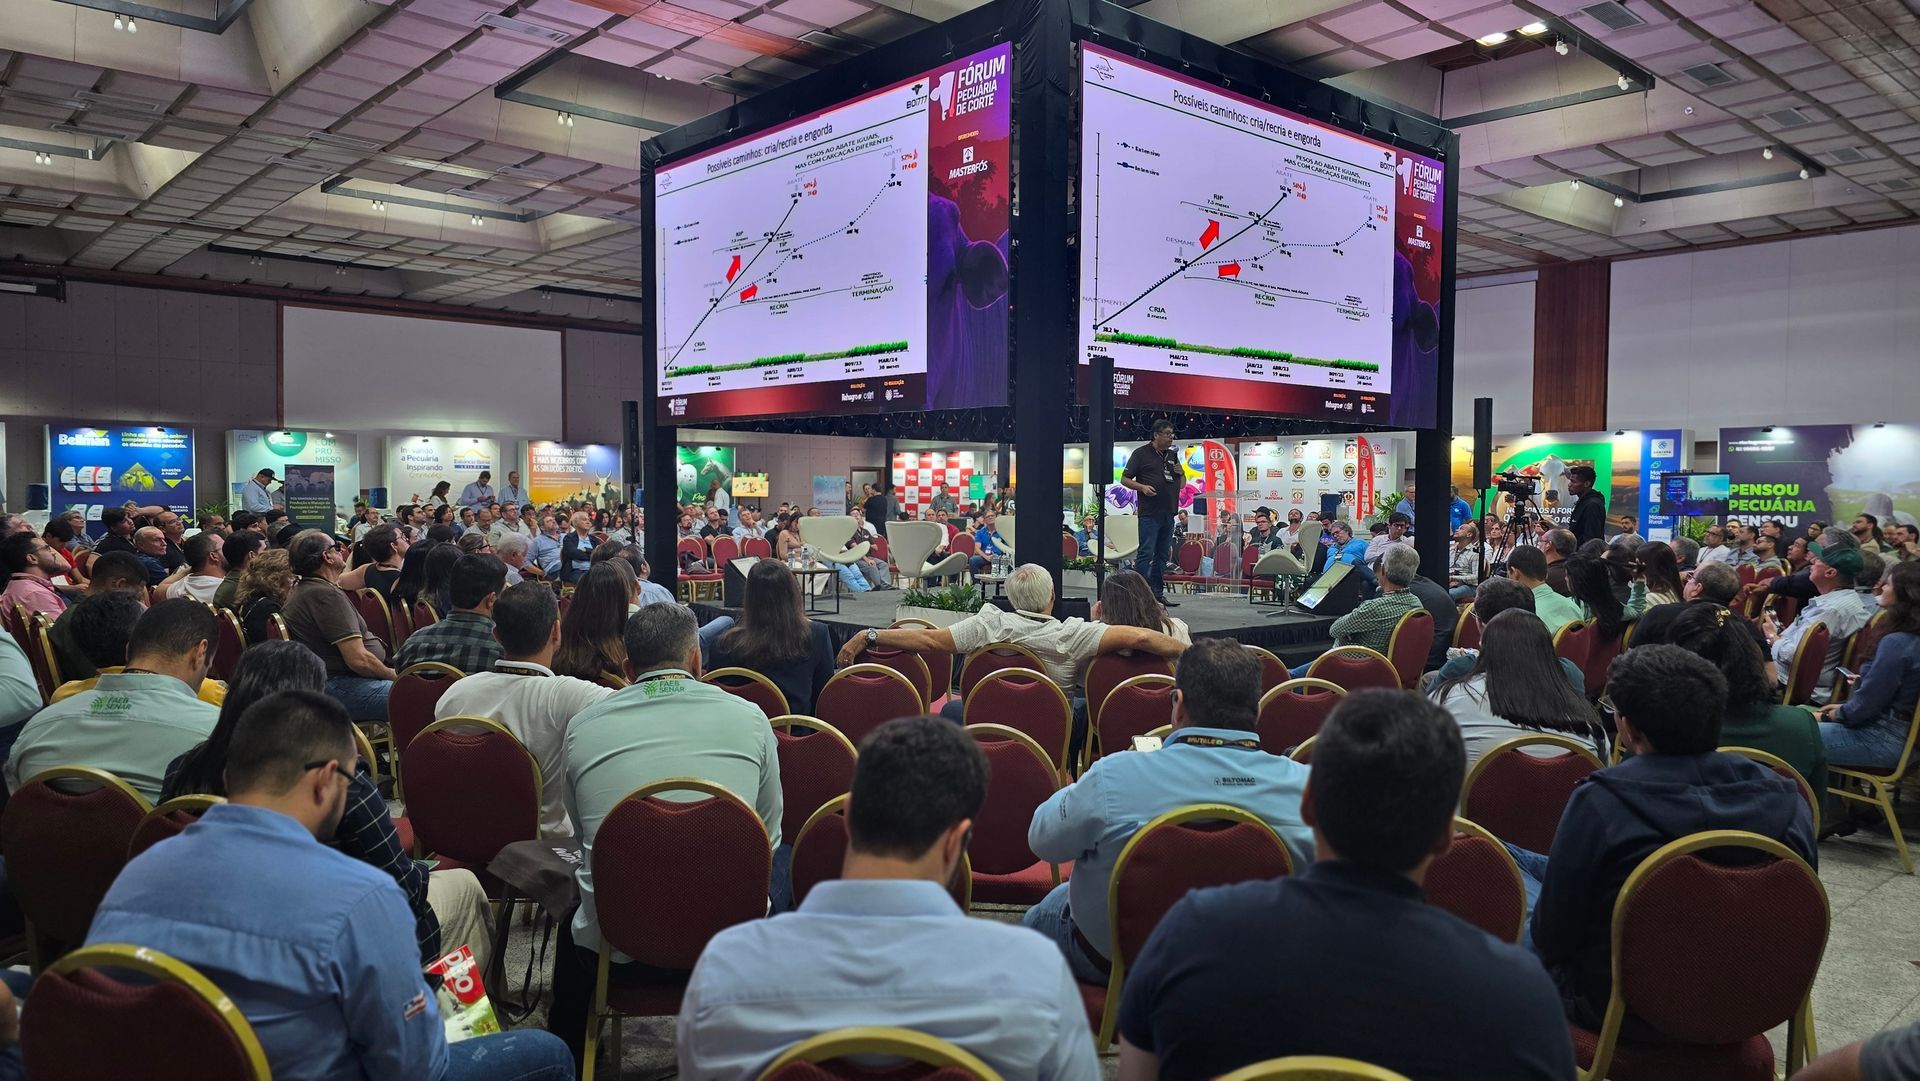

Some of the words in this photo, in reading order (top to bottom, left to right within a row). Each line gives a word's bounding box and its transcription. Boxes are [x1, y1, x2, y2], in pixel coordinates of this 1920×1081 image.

[958, 54, 1006, 88] FÓRUM
[957, 79, 997, 103] PECUÁRIA
[956, 103, 967, 116] DE
[968, 93, 994, 112] CORTE
[1173, 89, 1209, 112] Possíveis
[1209, 105, 1249, 125] caminhos:
[1250, 117, 1286, 136] cria/recria
[1287, 130, 1293, 139] e
[1293, 132, 1321, 148] engorda
[707, 158, 733, 174] Possíveis
[733, 147, 764, 166] caminhos:
[764, 138, 797, 156] cria/recria
[798, 134, 803, 144] e
[804, 122, 833, 142] engorda
[795, 162, 807, 170] MAS
[808, 157, 822, 166] COM
[855, 135, 894, 152] DIFERENTES
[806, 149, 826, 160] PESOS
[825, 145, 835, 153] AO
[835, 140, 856, 151] ABATE
[1134, 145, 1160, 157] Extensivo
[949, 160, 988, 180] MASTERFÓS
[1296, 154, 1313, 164] PESOS
[1314, 158, 1323, 166] AO
[1323, 162, 1342, 173] ABATE
[1284, 157, 1296, 166] MAS
[1297, 161, 1310, 170] COM
[1340, 174, 1371, 188] DIFERENTES
[1414, 160, 1442, 184] FÓRUM
[1413, 178, 1437, 194] PECUÁRIA
[1213, 193, 1224, 201] RIP
[1412, 188, 1420, 198] DE
[1419, 191, 1435, 203] CORTE
[1407, 236, 1431, 250] MASTERFÓS
[851, 285, 894, 298] TERMINAÇÃO
[1254, 293, 1276, 302] RECRIA
[769, 302, 789, 312] RECRIA
[1149, 306, 1166, 314] CRIA
[1336, 307, 1370, 318] TERMINAÇÃO
[1113, 372, 1134, 384] FÓRUM
[59, 431, 111, 447] Bellman
[406, 464, 443, 472] Inspirando
[533, 464, 540, 472] AS
[576, 457, 587, 465] COM
[1729, 484, 1799, 496] PENSOU
[1728, 497, 1816, 512] PECUÁRIA
[659, 686, 686, 694] SENAR
